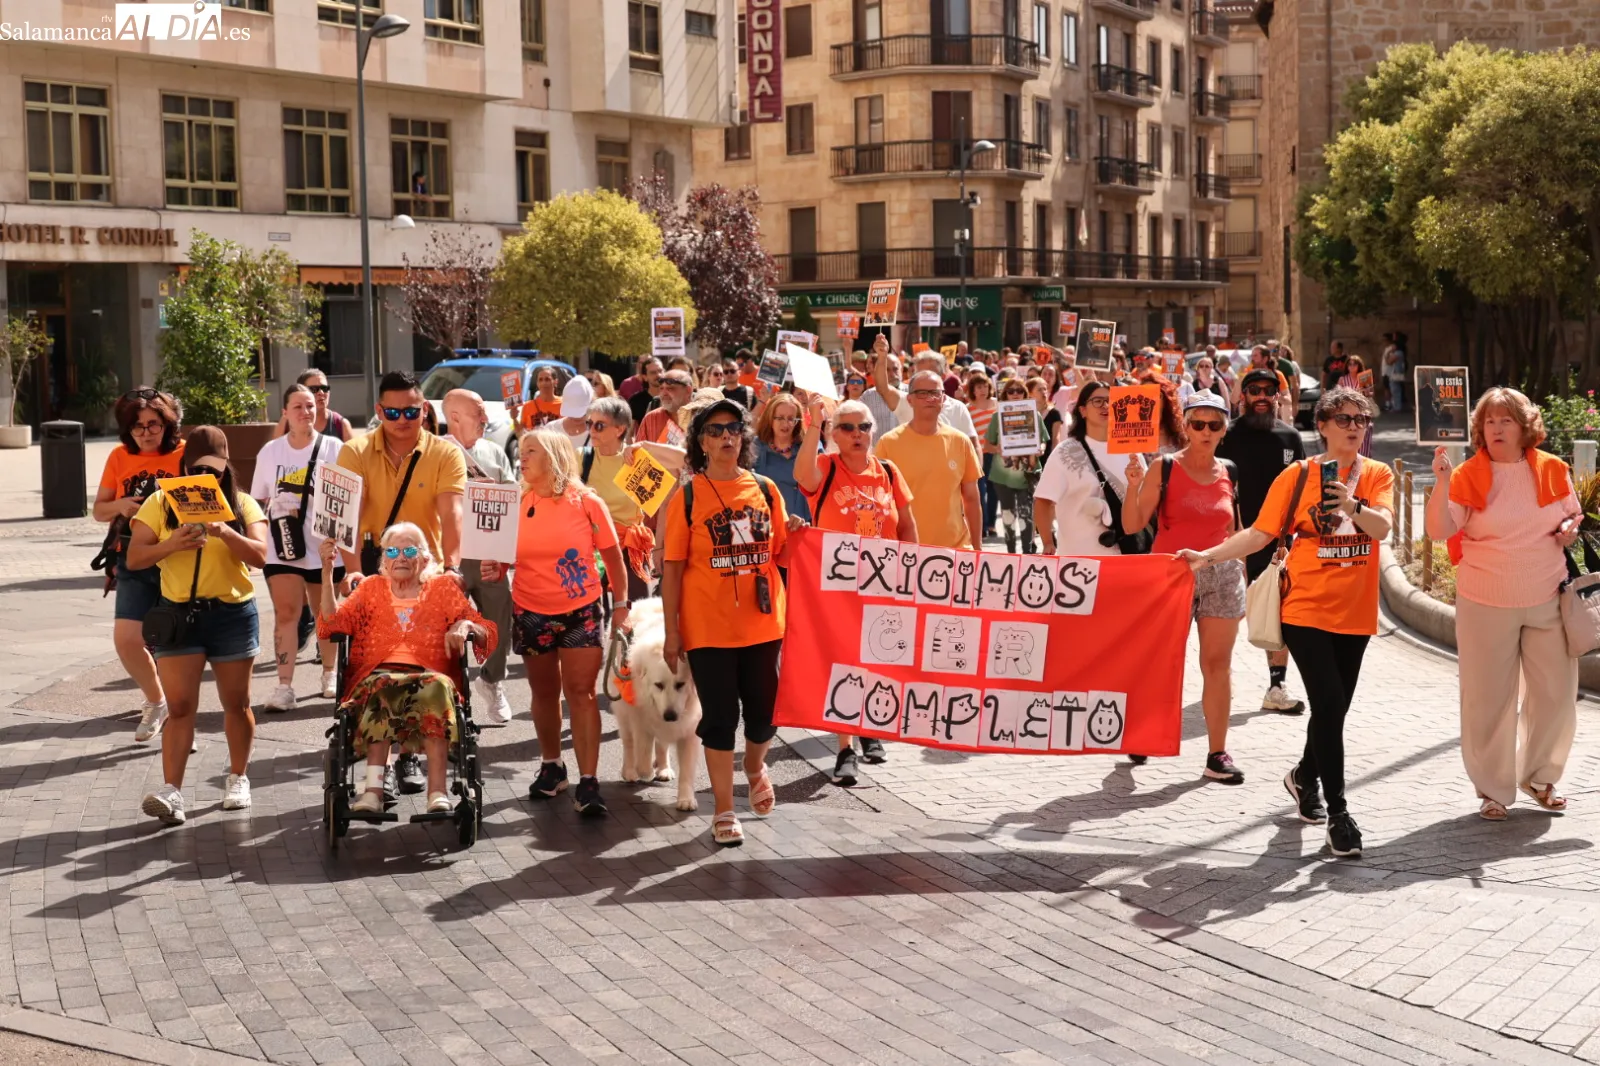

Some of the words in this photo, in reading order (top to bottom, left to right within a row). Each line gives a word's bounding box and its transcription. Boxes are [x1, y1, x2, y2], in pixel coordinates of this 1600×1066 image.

[70, 225, 90, 245] R.
[96, 226, 178, 247] CONDAL
[826, 293, 863, 305] CHIGRE
[878, 295, 888, 304] LEY
[1093, 333, 1110, 342] SOLA
[1436, 377, 1444, 386] NO
[1445, 376, 1463, 386] ESTÁS
[1439, 385, 1464, 399] SOLA
[321, 467, 334, 482] LOS
[336, 472, 359, 493] GATOS
[324, 481, 350, 502] TIENEN
[469, 488, 485, 500] LOS
[488, 489, 516, 503] GATOS
[327, 497, 343, 516] LEY
[474, 500, 507, 515] TIENEN
[479, 514, 499, 530] LEY
[282, 522, 294, 557] adidas
[748, 553, 758, 564] LA
[827, 540, 1098, 609] EXIGIMOS
[825, 673, 1124, 747] COMPLETO
